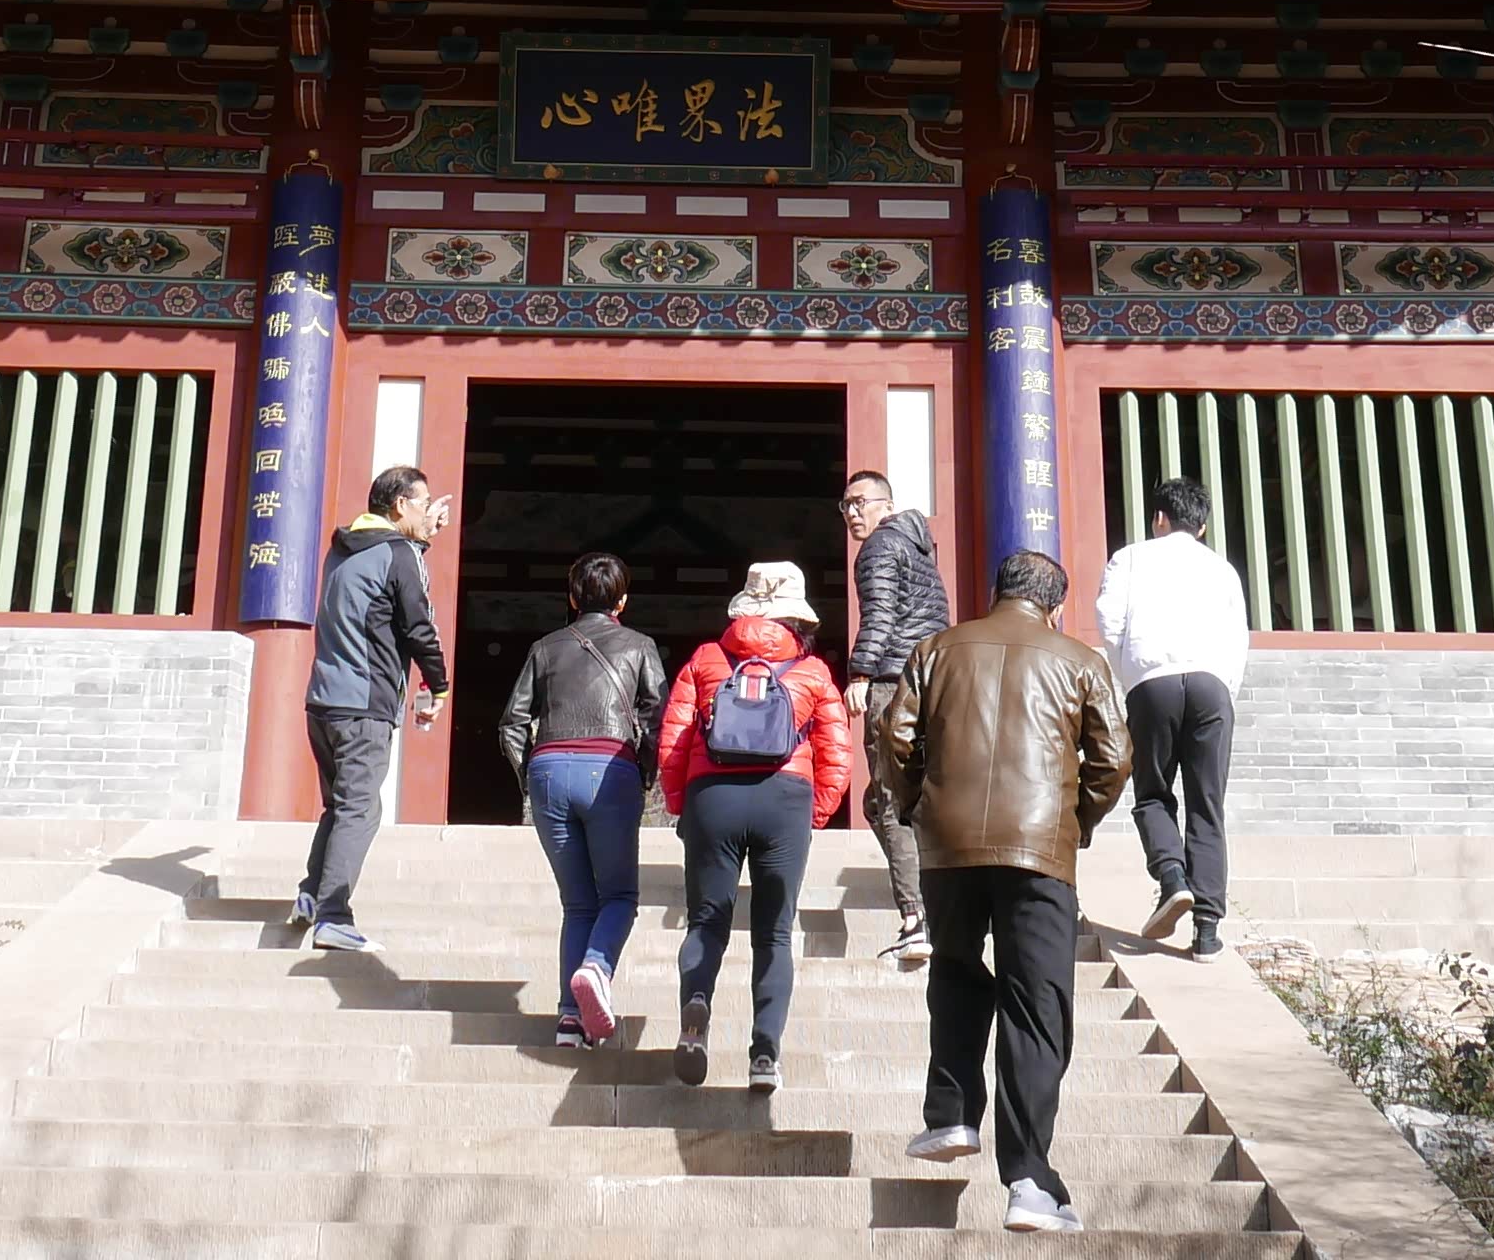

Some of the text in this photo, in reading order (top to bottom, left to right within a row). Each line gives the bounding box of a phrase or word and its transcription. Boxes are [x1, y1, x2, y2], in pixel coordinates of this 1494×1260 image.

[540, 78, 783, 142] 法界唯心
[987, 237, 1017, 352] 名利客
